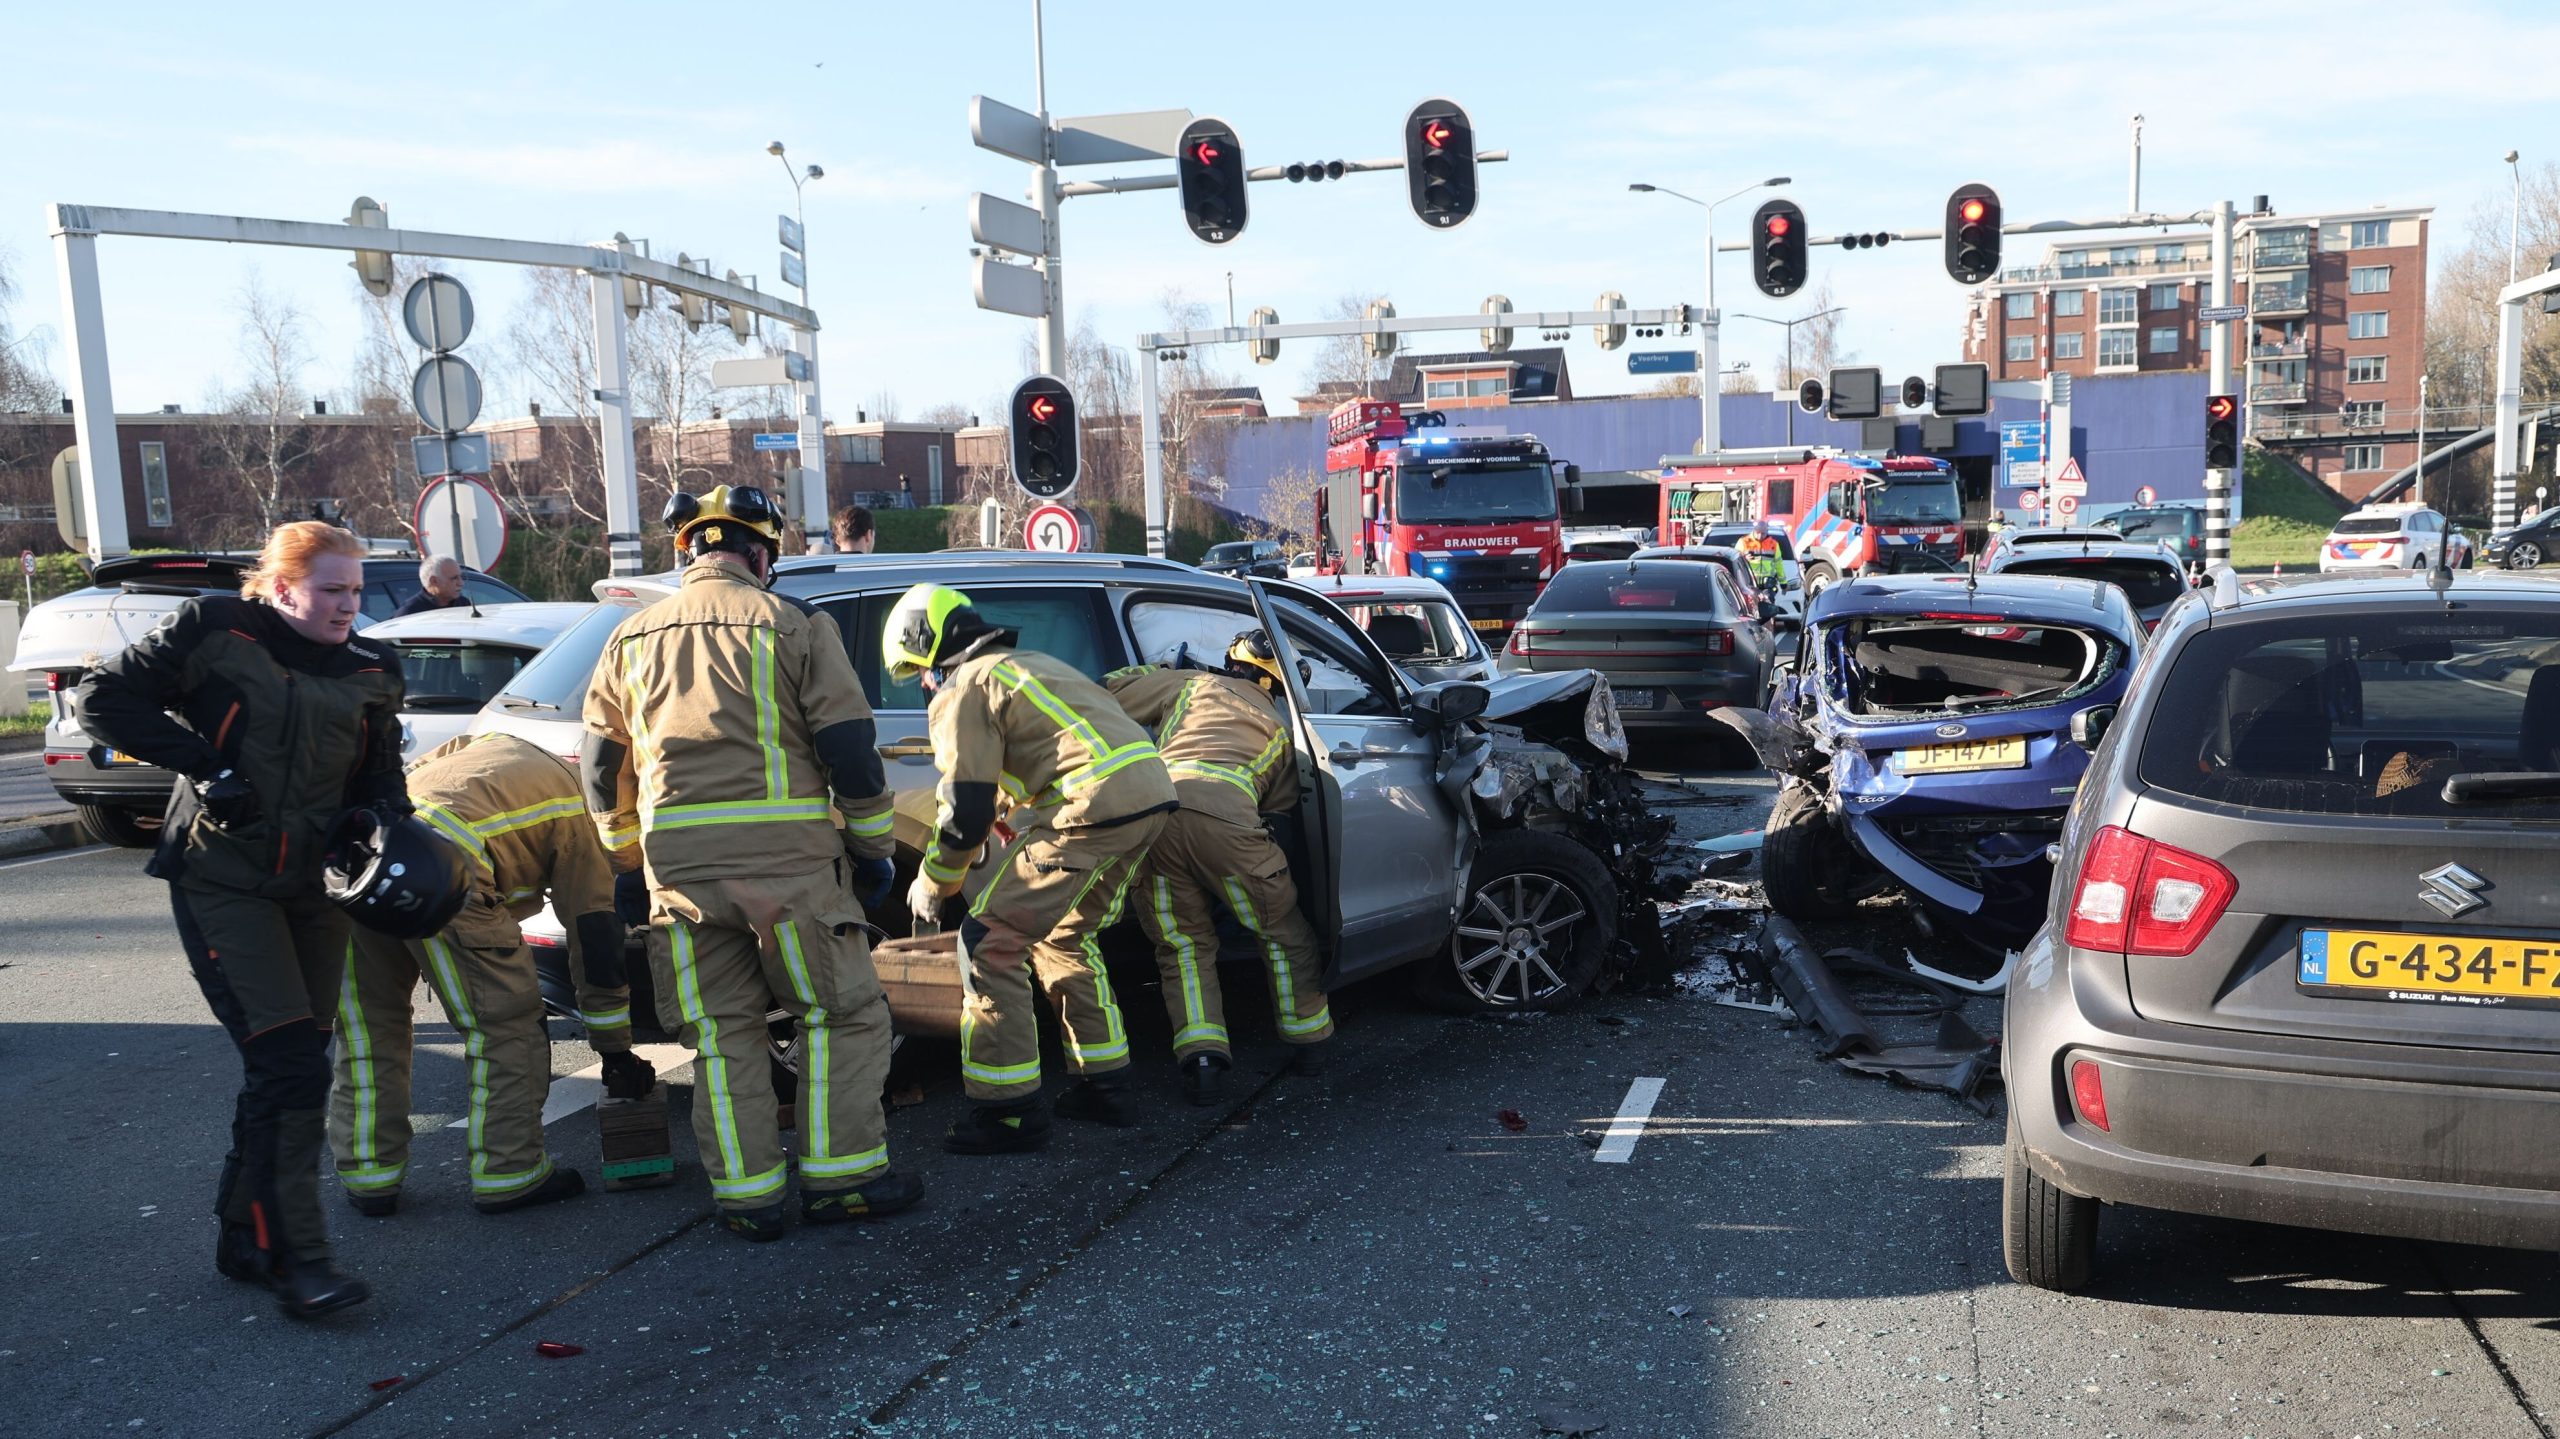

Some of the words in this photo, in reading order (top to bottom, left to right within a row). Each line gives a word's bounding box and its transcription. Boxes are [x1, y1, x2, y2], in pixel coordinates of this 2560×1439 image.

[1211, 231, 1224, 240] 9.2
[1637, 354, 1669, 362] Voorburg
[1428, 457, 1476, 465] LEIDSCHENDAM
[1041, 485, 1054, 493] 9.3
[2024, 496, 2036, 505] 50
[1899, 526, 1944, 535] BRANDWEER
[1444, 536, 1519, 548] BRANDWEER
[1919, 739, 2010, 764] JF-147-P
[2304, 963, 2323, 975] NL
[2399, 992, 2436, 1001] SUZUKI
[2441, 994, 2457, 1002] Den
[2459, 995, 2481, 1004] Haag
